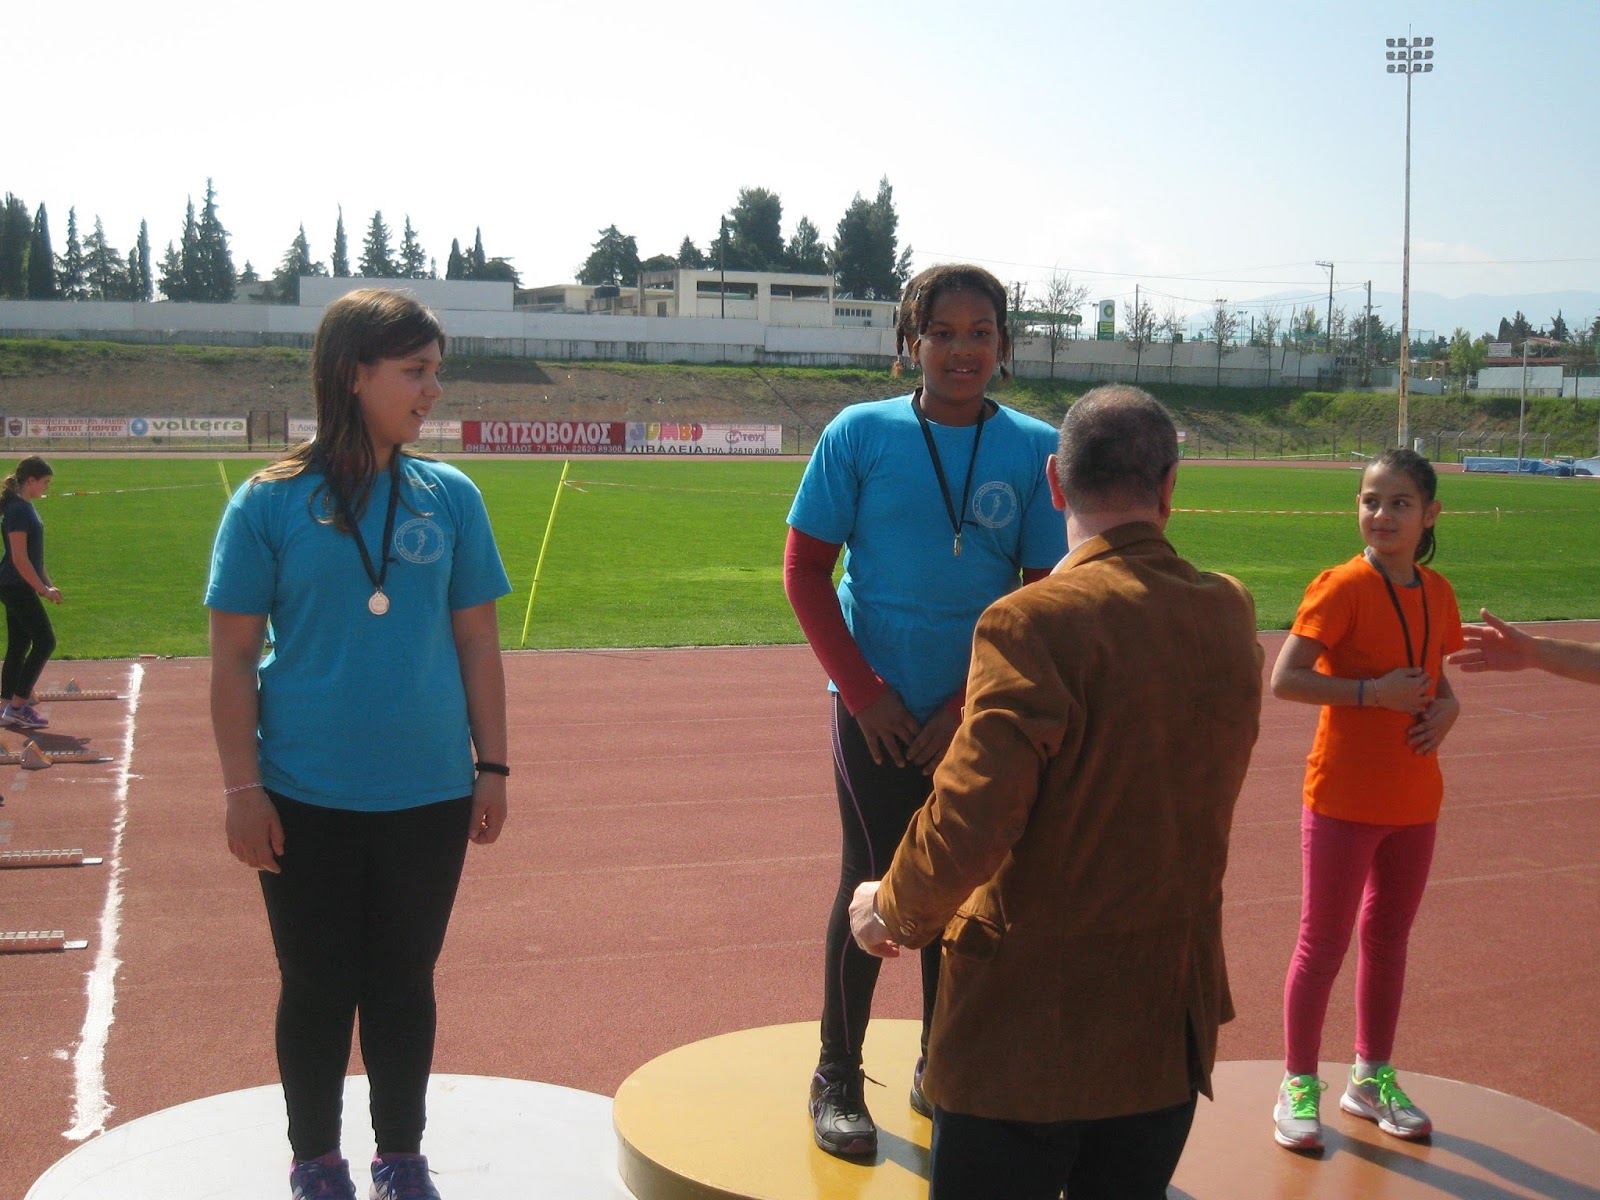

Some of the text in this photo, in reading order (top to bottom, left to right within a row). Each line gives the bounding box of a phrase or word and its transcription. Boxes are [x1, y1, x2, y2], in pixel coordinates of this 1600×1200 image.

[152, 418, 244, 431] volterra
[480, 421, 611, 444] ΚΩΤΣΟΒΟΛΟΣ
[629, 421, 703, 442] JUMBO
[465, 444, 491, 452] ΘΗΒΑ
[536, 445, 547, 453] 79
[572, 445, 596, 453] 22620
[599, 445, 623, 453] 89300
